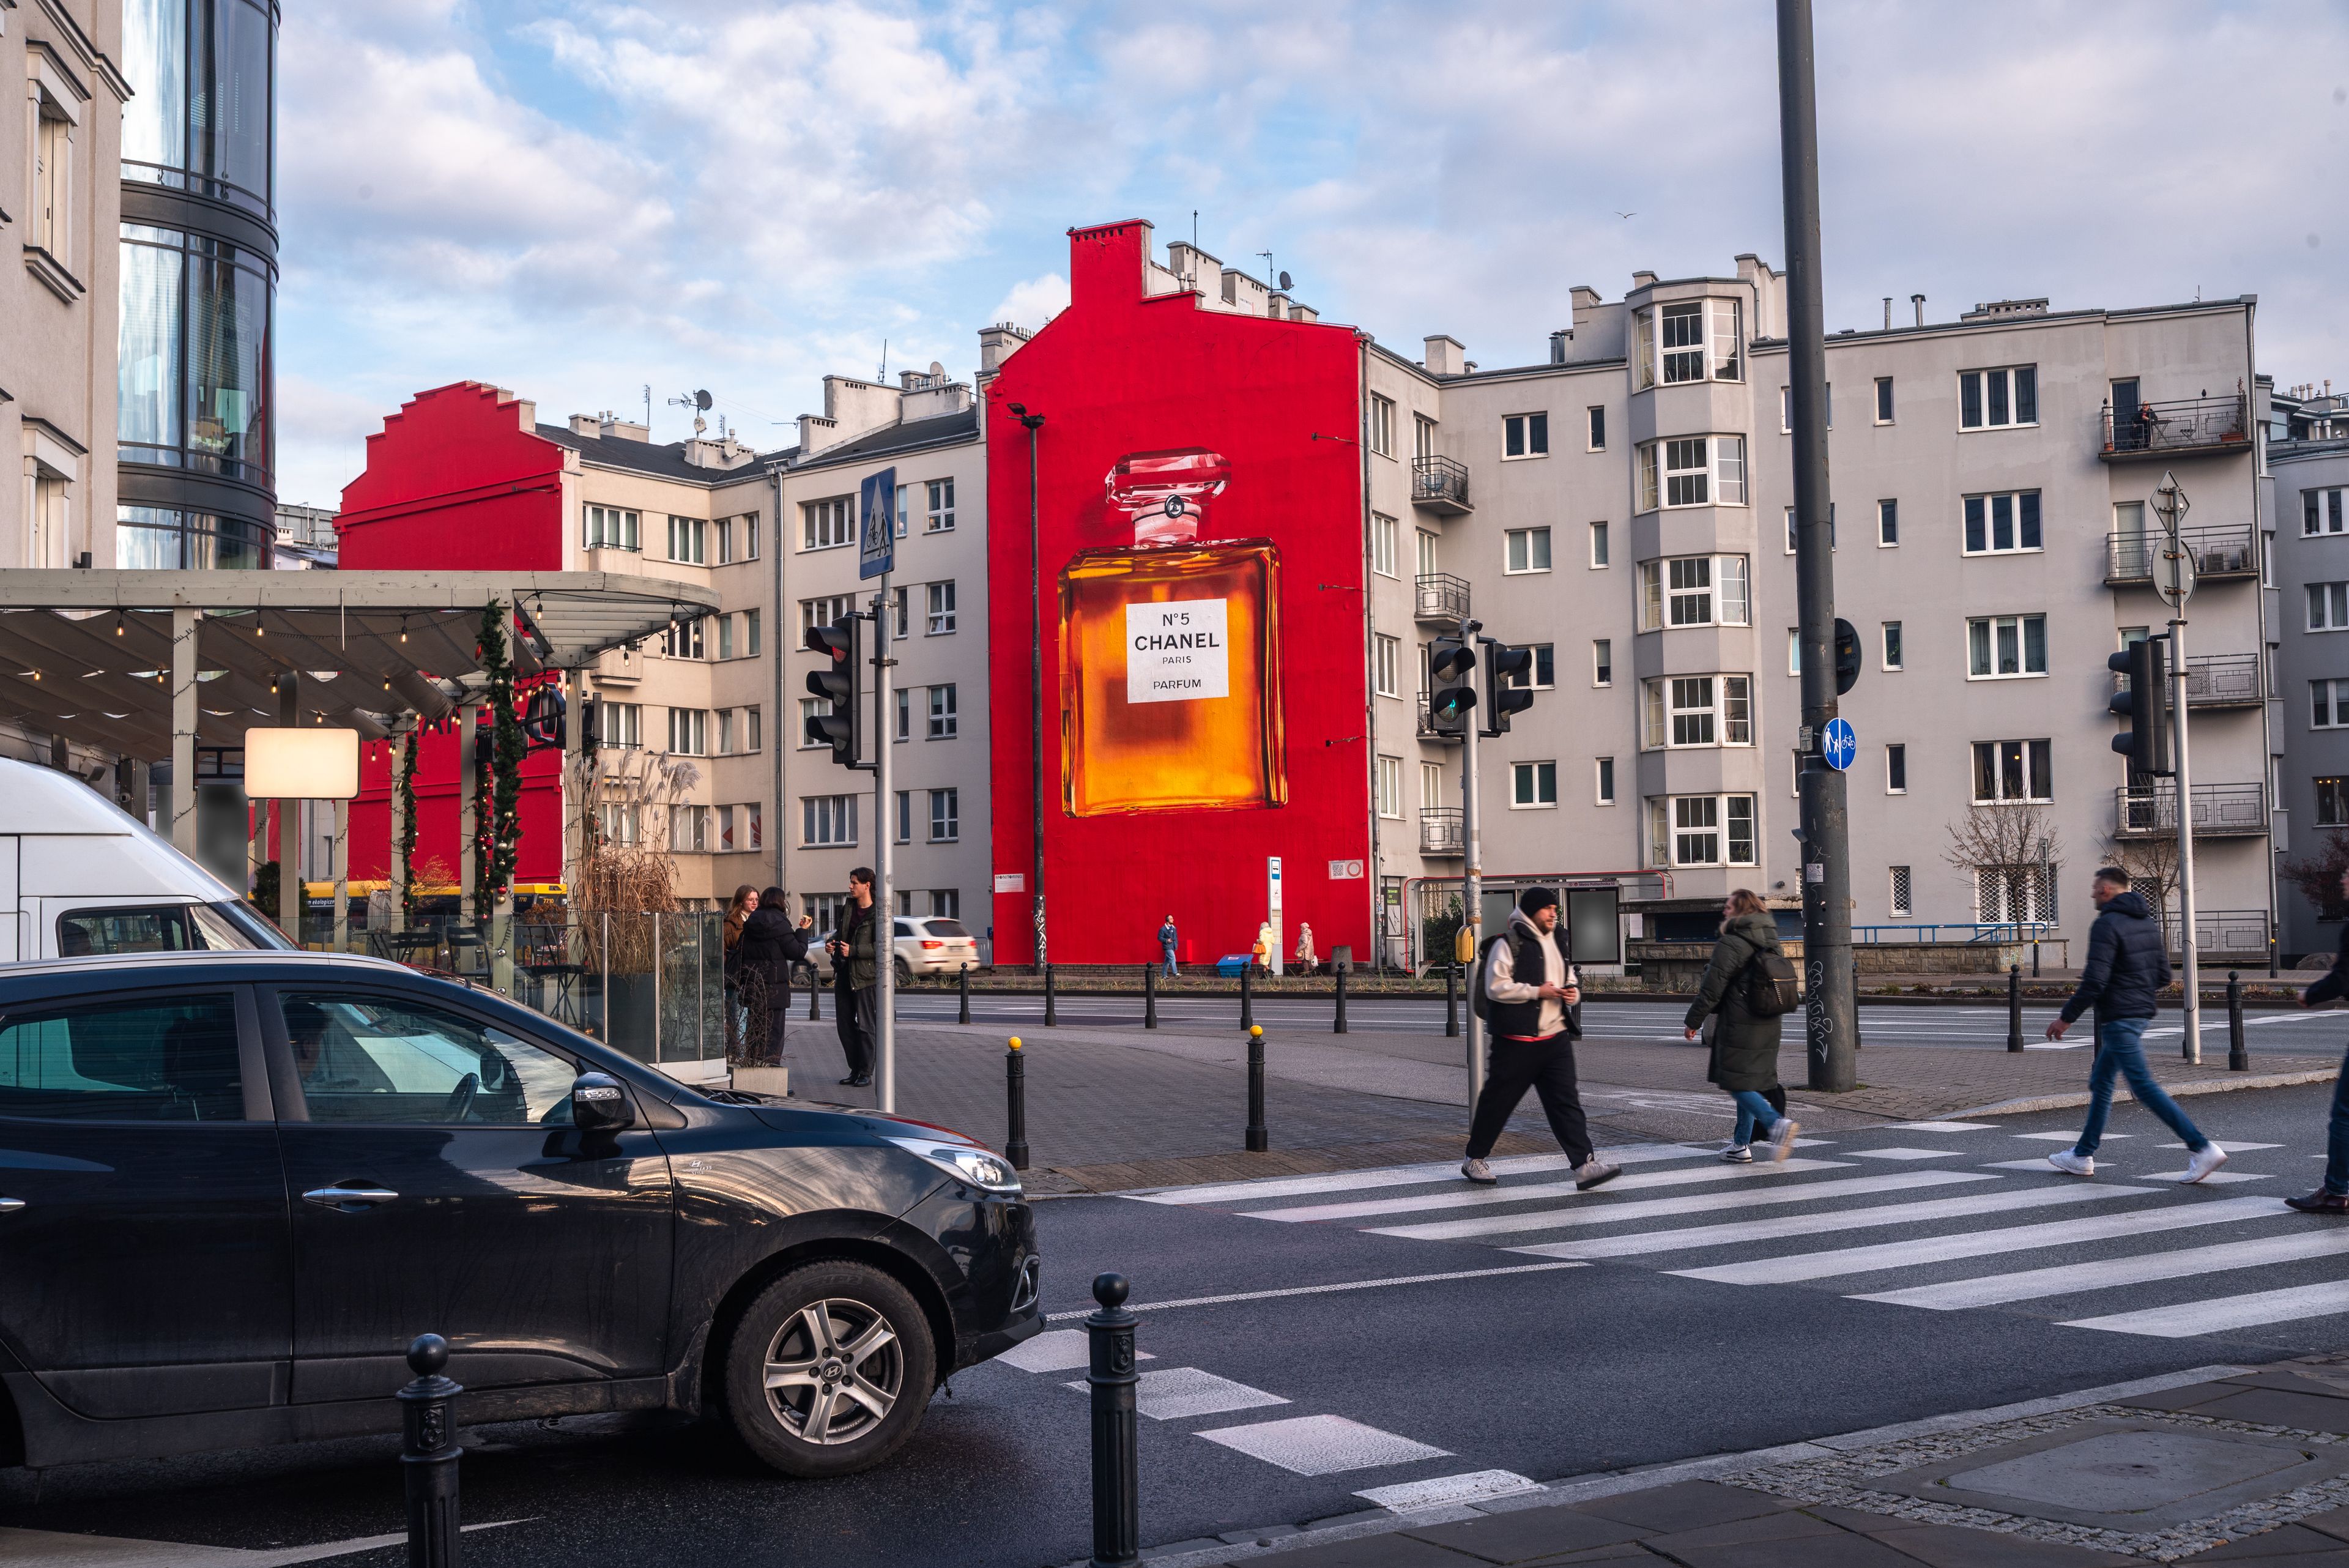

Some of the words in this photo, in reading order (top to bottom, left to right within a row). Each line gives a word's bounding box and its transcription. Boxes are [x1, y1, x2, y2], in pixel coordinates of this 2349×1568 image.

[1135, 632, 1220, 651] CHANEL
[1162, 656, 1192, 664] PARIS
[1153, 679, 1201, 689] PARFUM
